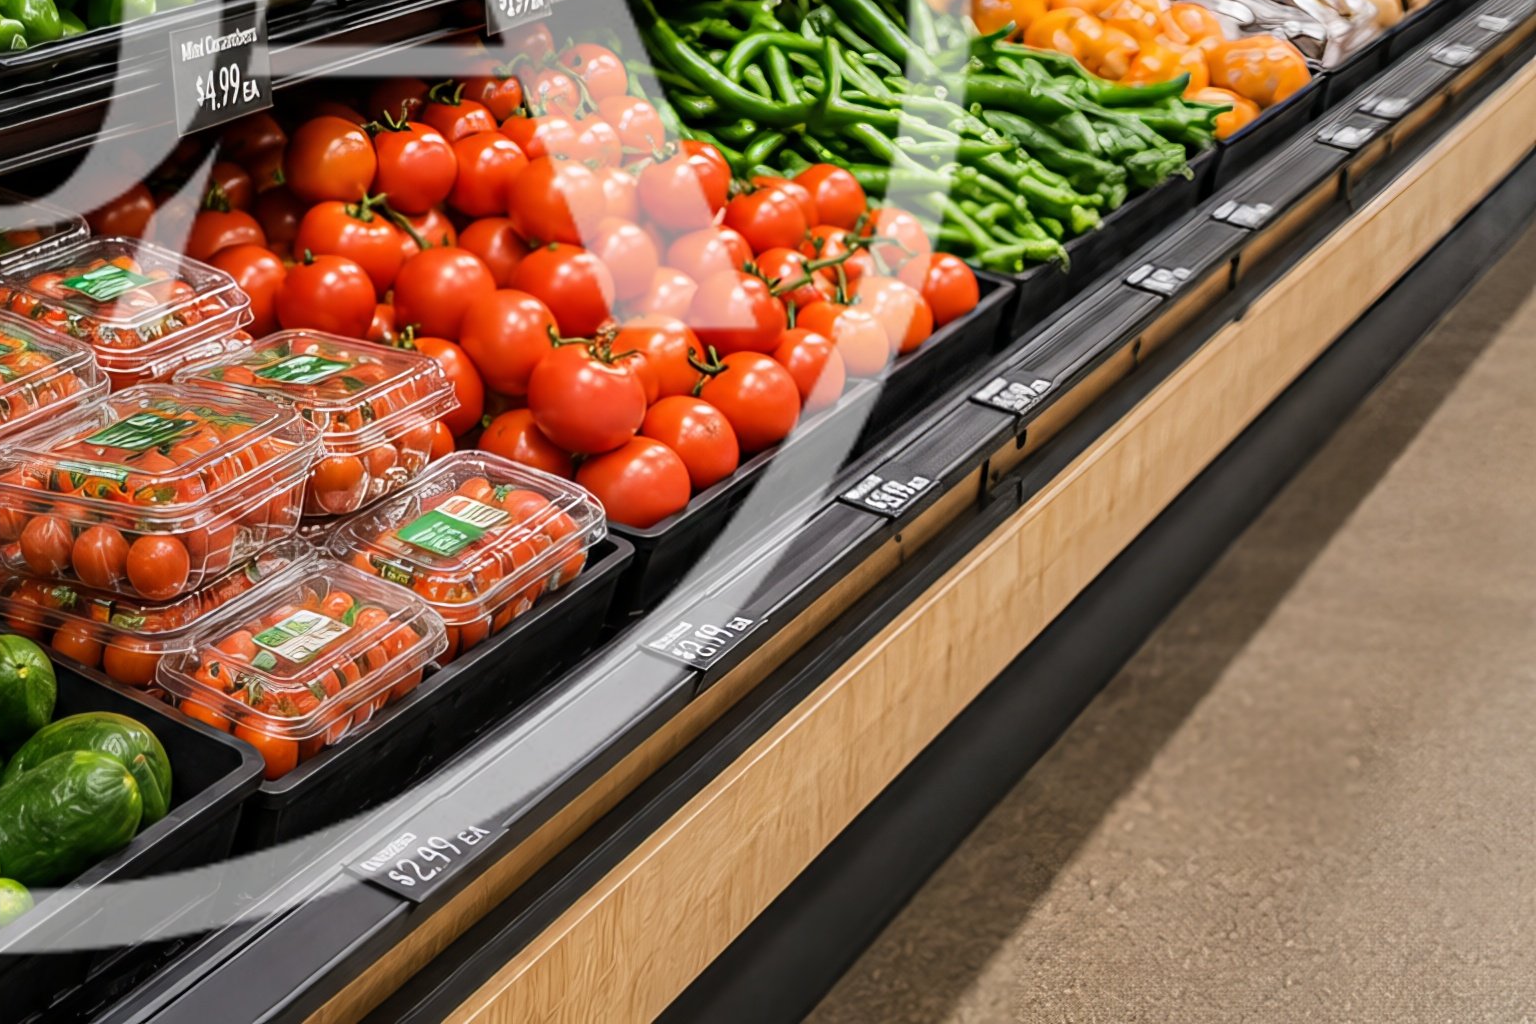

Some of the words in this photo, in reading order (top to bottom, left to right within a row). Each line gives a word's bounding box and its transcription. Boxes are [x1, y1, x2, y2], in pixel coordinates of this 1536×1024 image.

[196, 62, 240, 111] $4.99
[243, 79, 260, 102] EA
[389, 836, 461, 886] $2.99
